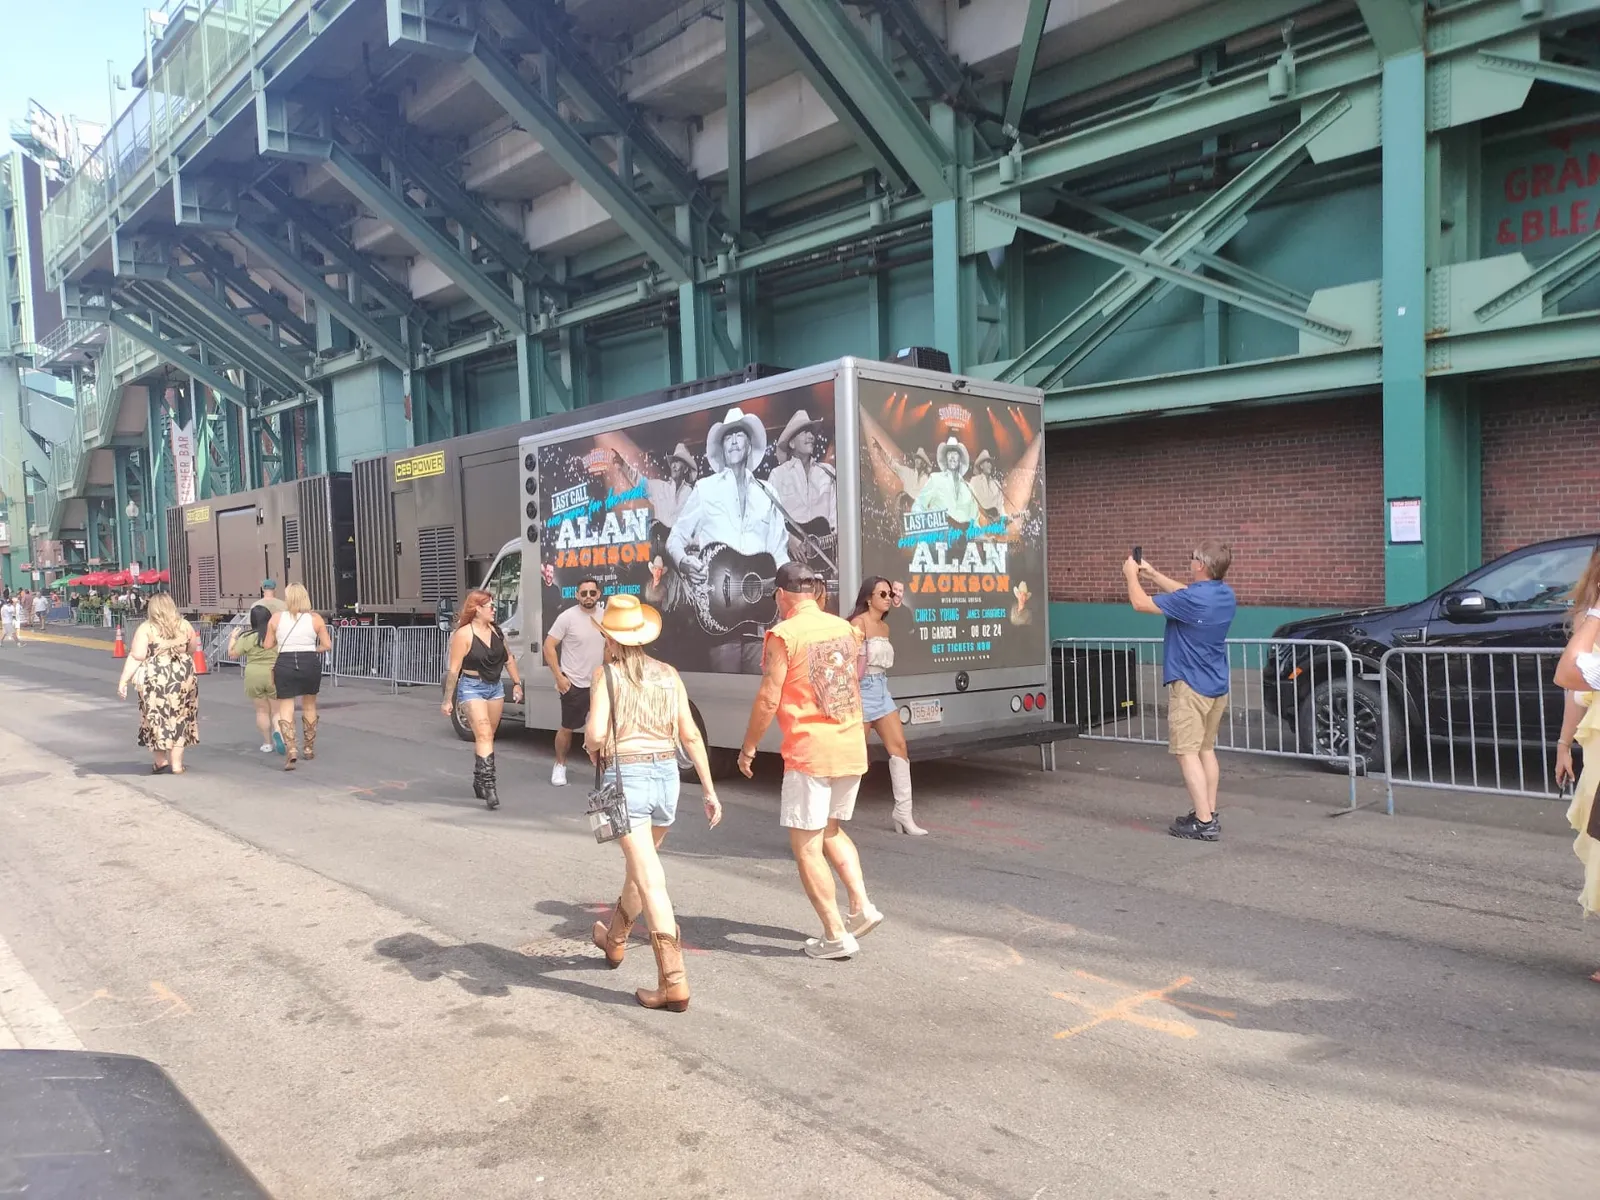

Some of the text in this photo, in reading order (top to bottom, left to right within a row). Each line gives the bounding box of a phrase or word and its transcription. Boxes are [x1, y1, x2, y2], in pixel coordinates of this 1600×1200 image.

[1521, 200, 1600, 244] BLE
[178, 435, 190, 457] BAR
[396, 457, 443, 476] CES POWER
[551, 486, 589, 512] LAST CALL
[555, 507, 649, 549] ALAN
[904, 510, 949, 531] LAST CALL
[555, 543, 652, 568] JACKSON
[909, 541, 1008, 573] ALAN
[909, 574, 1010, 593] JACKSON
[915, 607, 960, 622] CHRIS YOUNG
[919, 625, 957, 641] TD GARDEN
[982, 624, 991, 637] 02
[993, 623, 1002, 637] 24
[931, 641, 991, 653] GET TICKETS NOW
